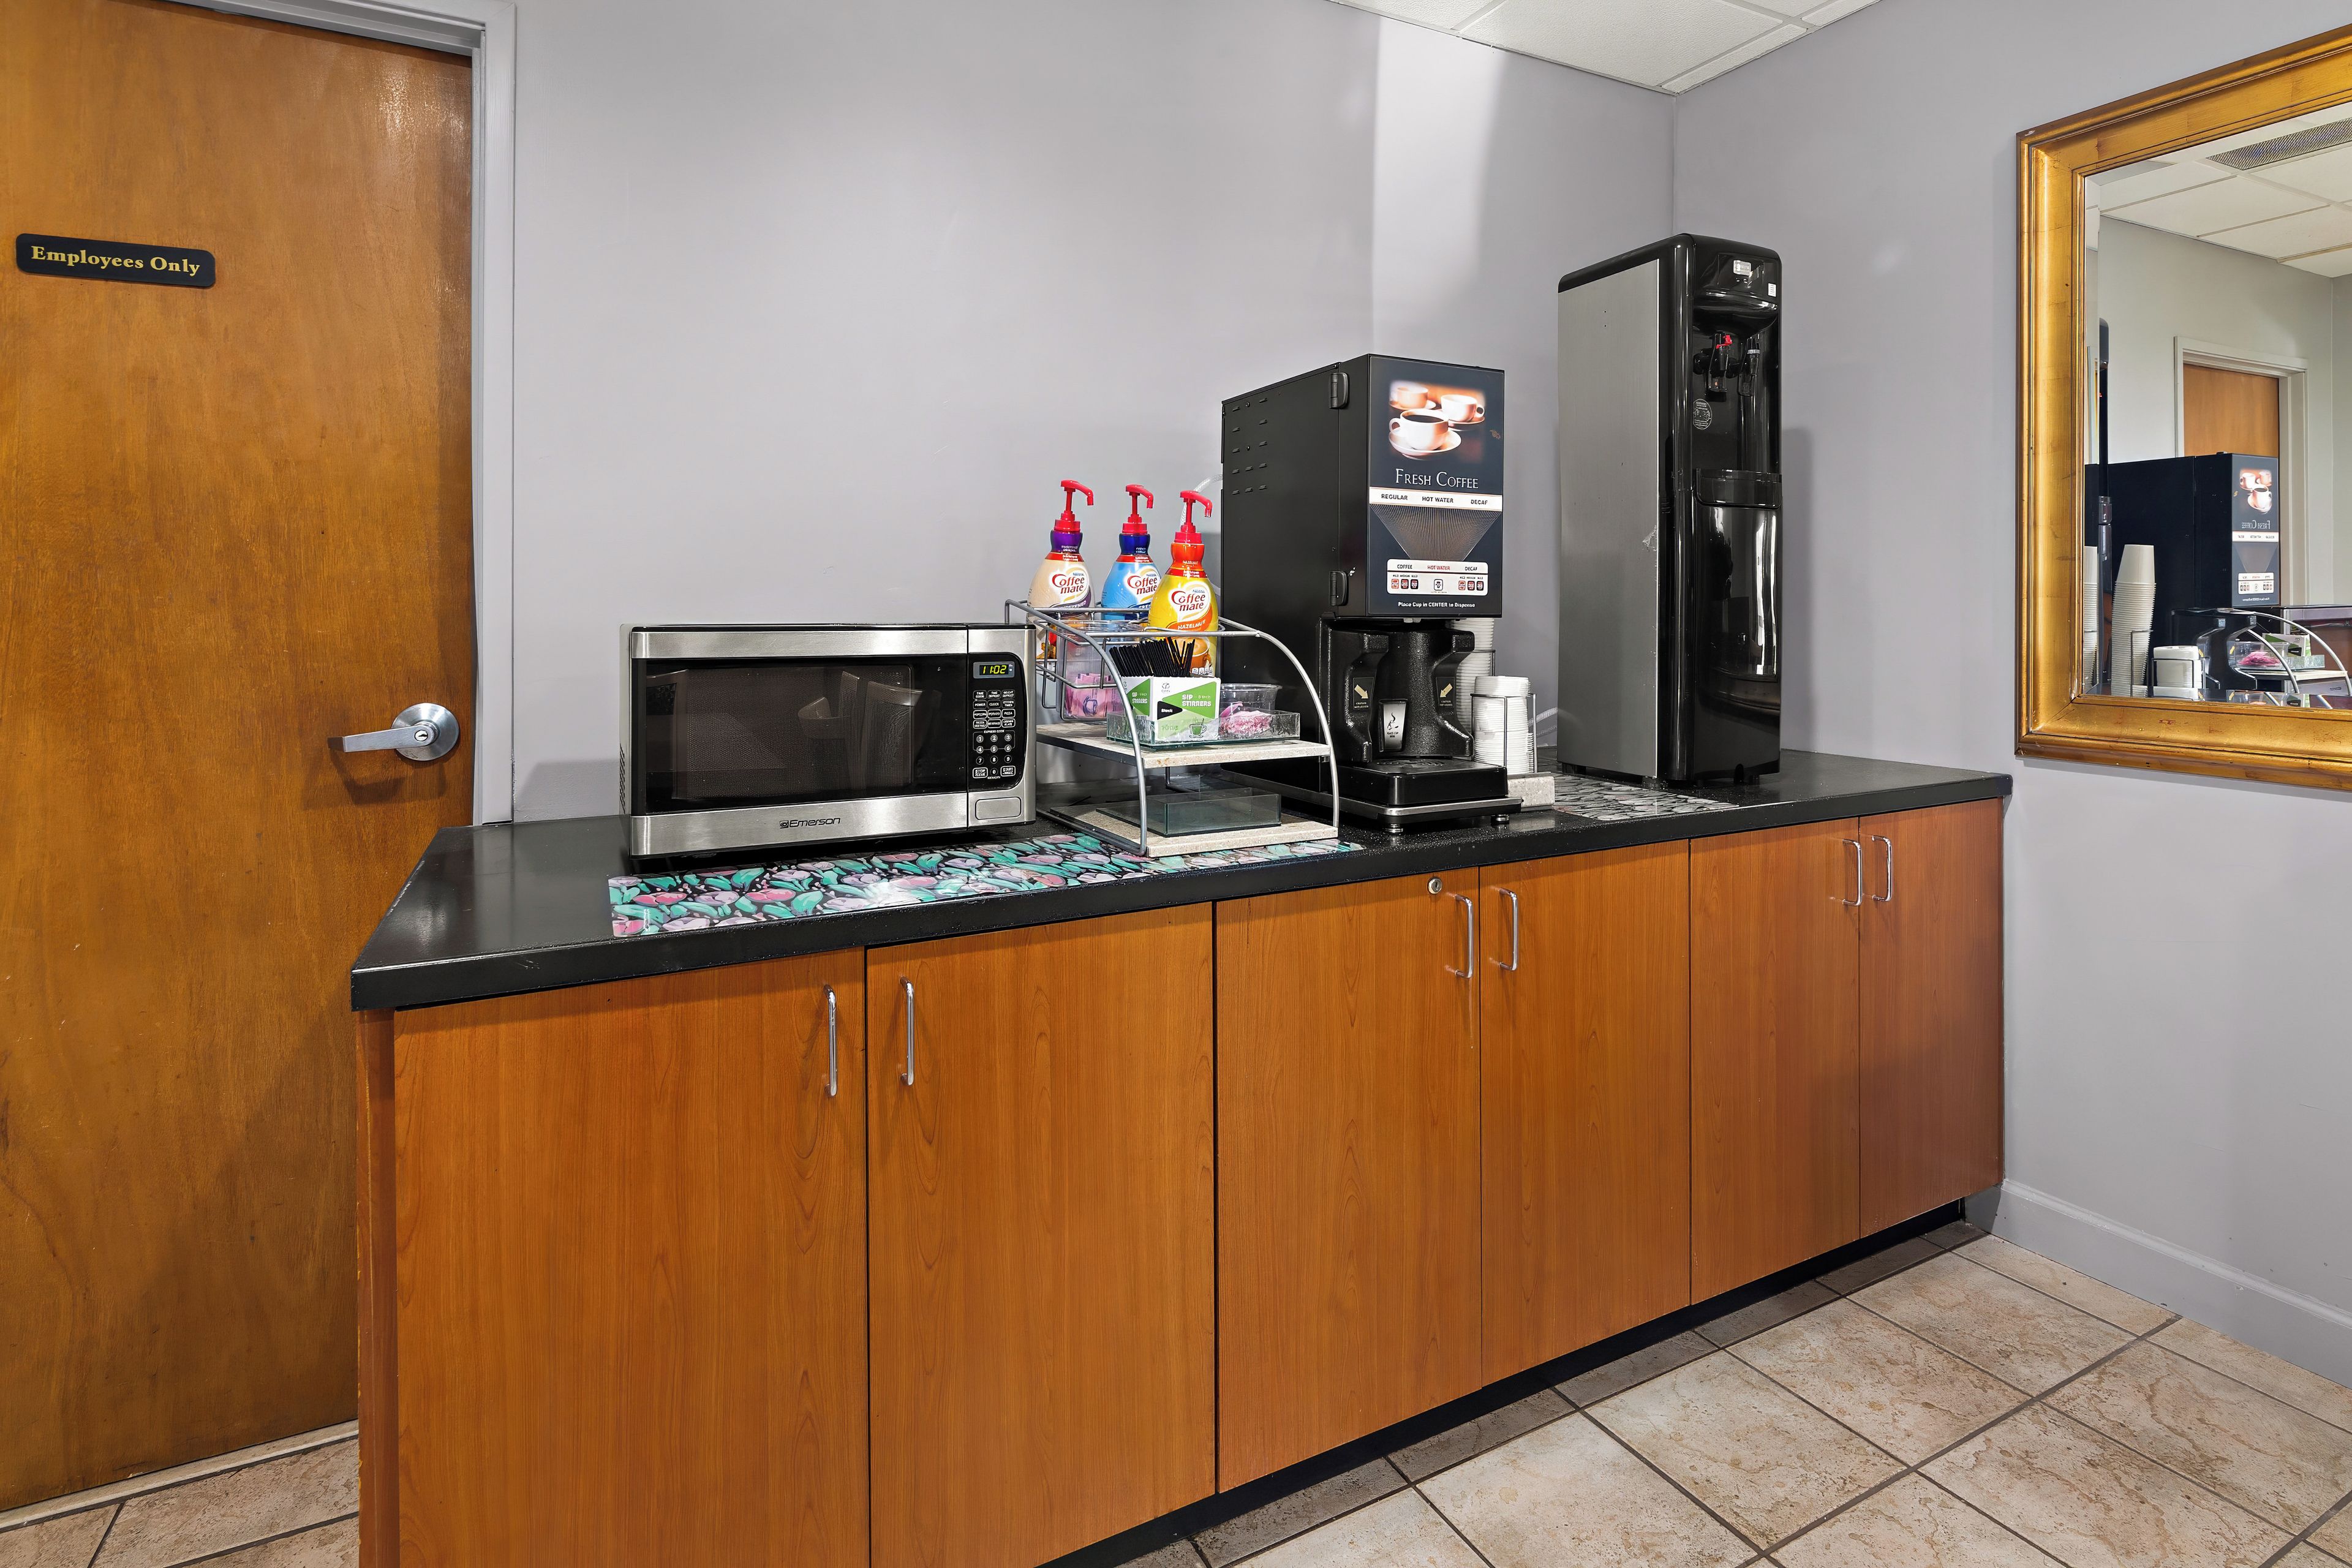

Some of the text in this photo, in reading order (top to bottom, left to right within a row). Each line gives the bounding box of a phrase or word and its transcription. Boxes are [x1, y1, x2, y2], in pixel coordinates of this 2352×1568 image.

[31, 246, 200, 277] Employees Only
[1395, 468, 1479, 489] FRESH COFFEE
[1052, 574, 1085, 587] Coffee
[1127, 575, 1158, 589] Coffee
[1060, 584, 1084, 594] mate
[1137, 584, 1157, 595] mate
[1171, 590, 1205, 605] Coffee
[1179, 601, 1204, 611] mate
[1177, 619, 1206, 630] HAZELNUT
[982, 665, 1007, 674] 11:02
[789, 818, 840, 827] Emerson
